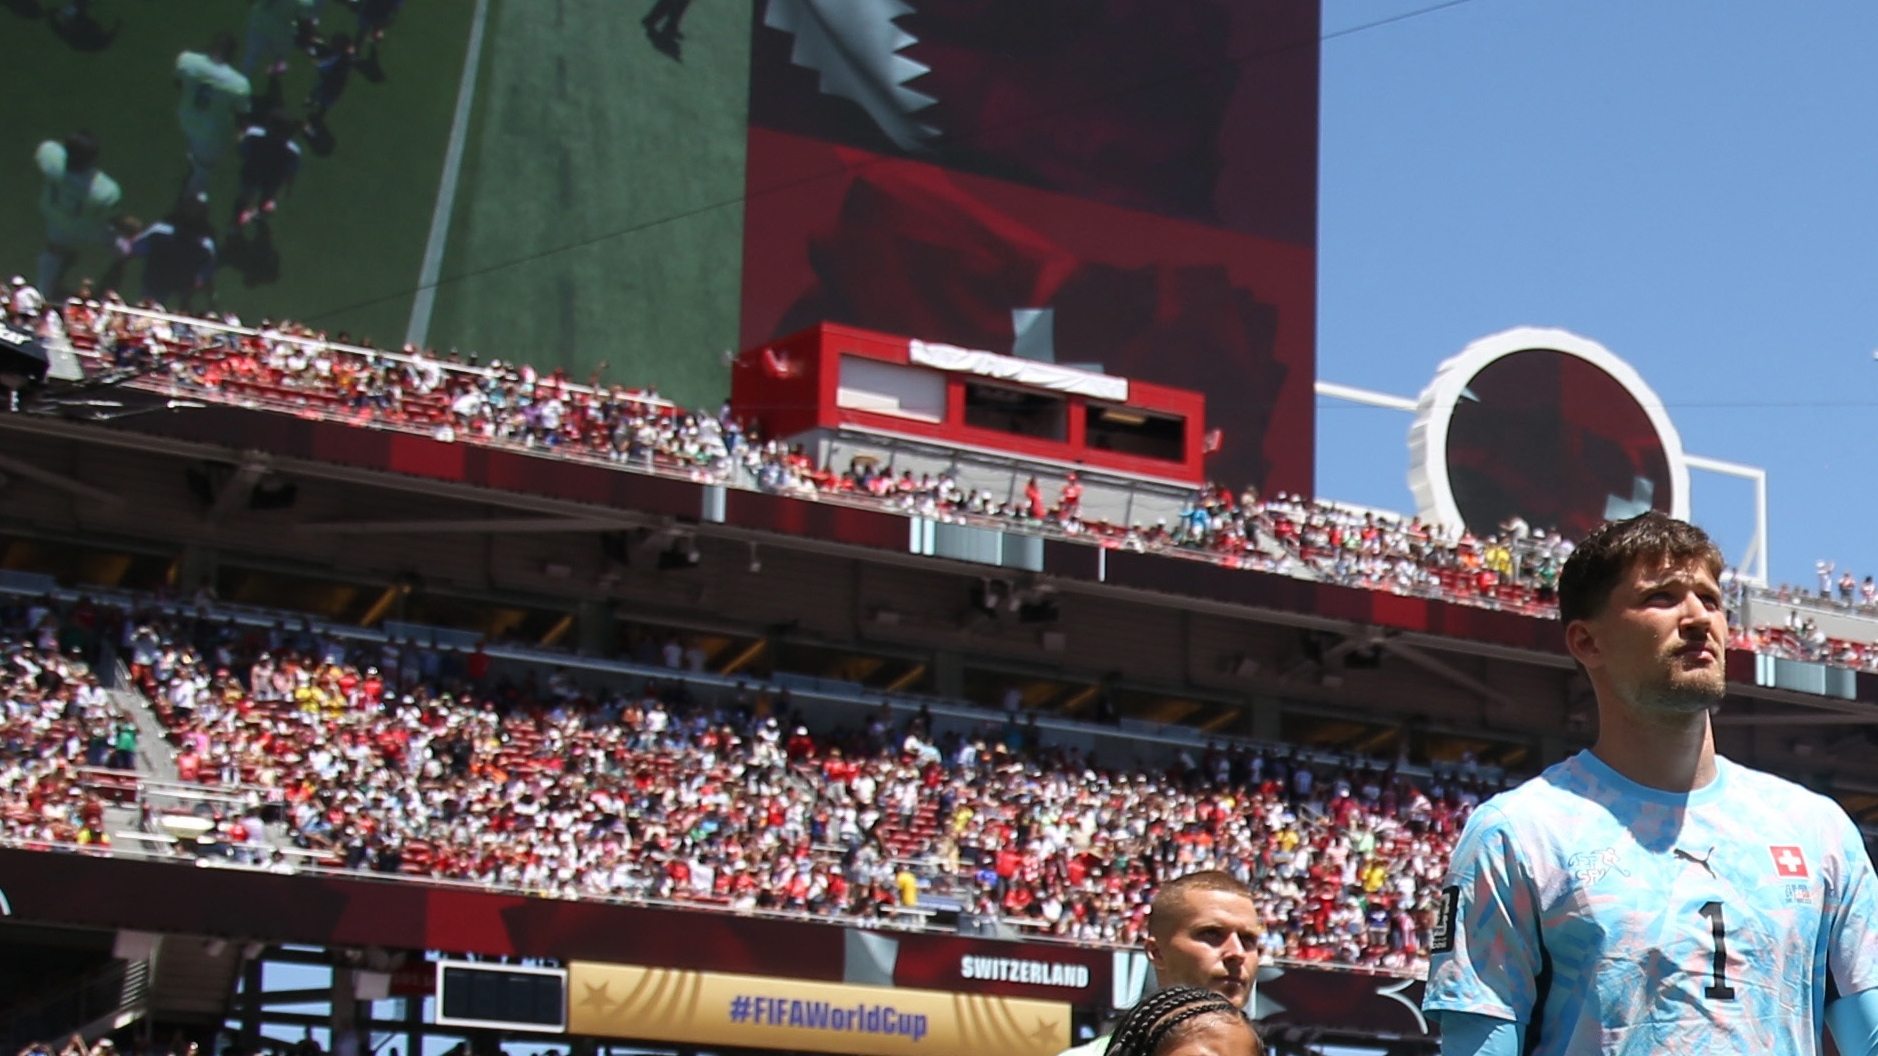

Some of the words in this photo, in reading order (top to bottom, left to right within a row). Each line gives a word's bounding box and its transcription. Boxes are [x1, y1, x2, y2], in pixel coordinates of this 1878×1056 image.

[961, 955, 1089, 988] SWITZERLAND
[1698, 901, 1735, 999] 1
[730, 995, 927, 1041] #FIFAWorldCup
